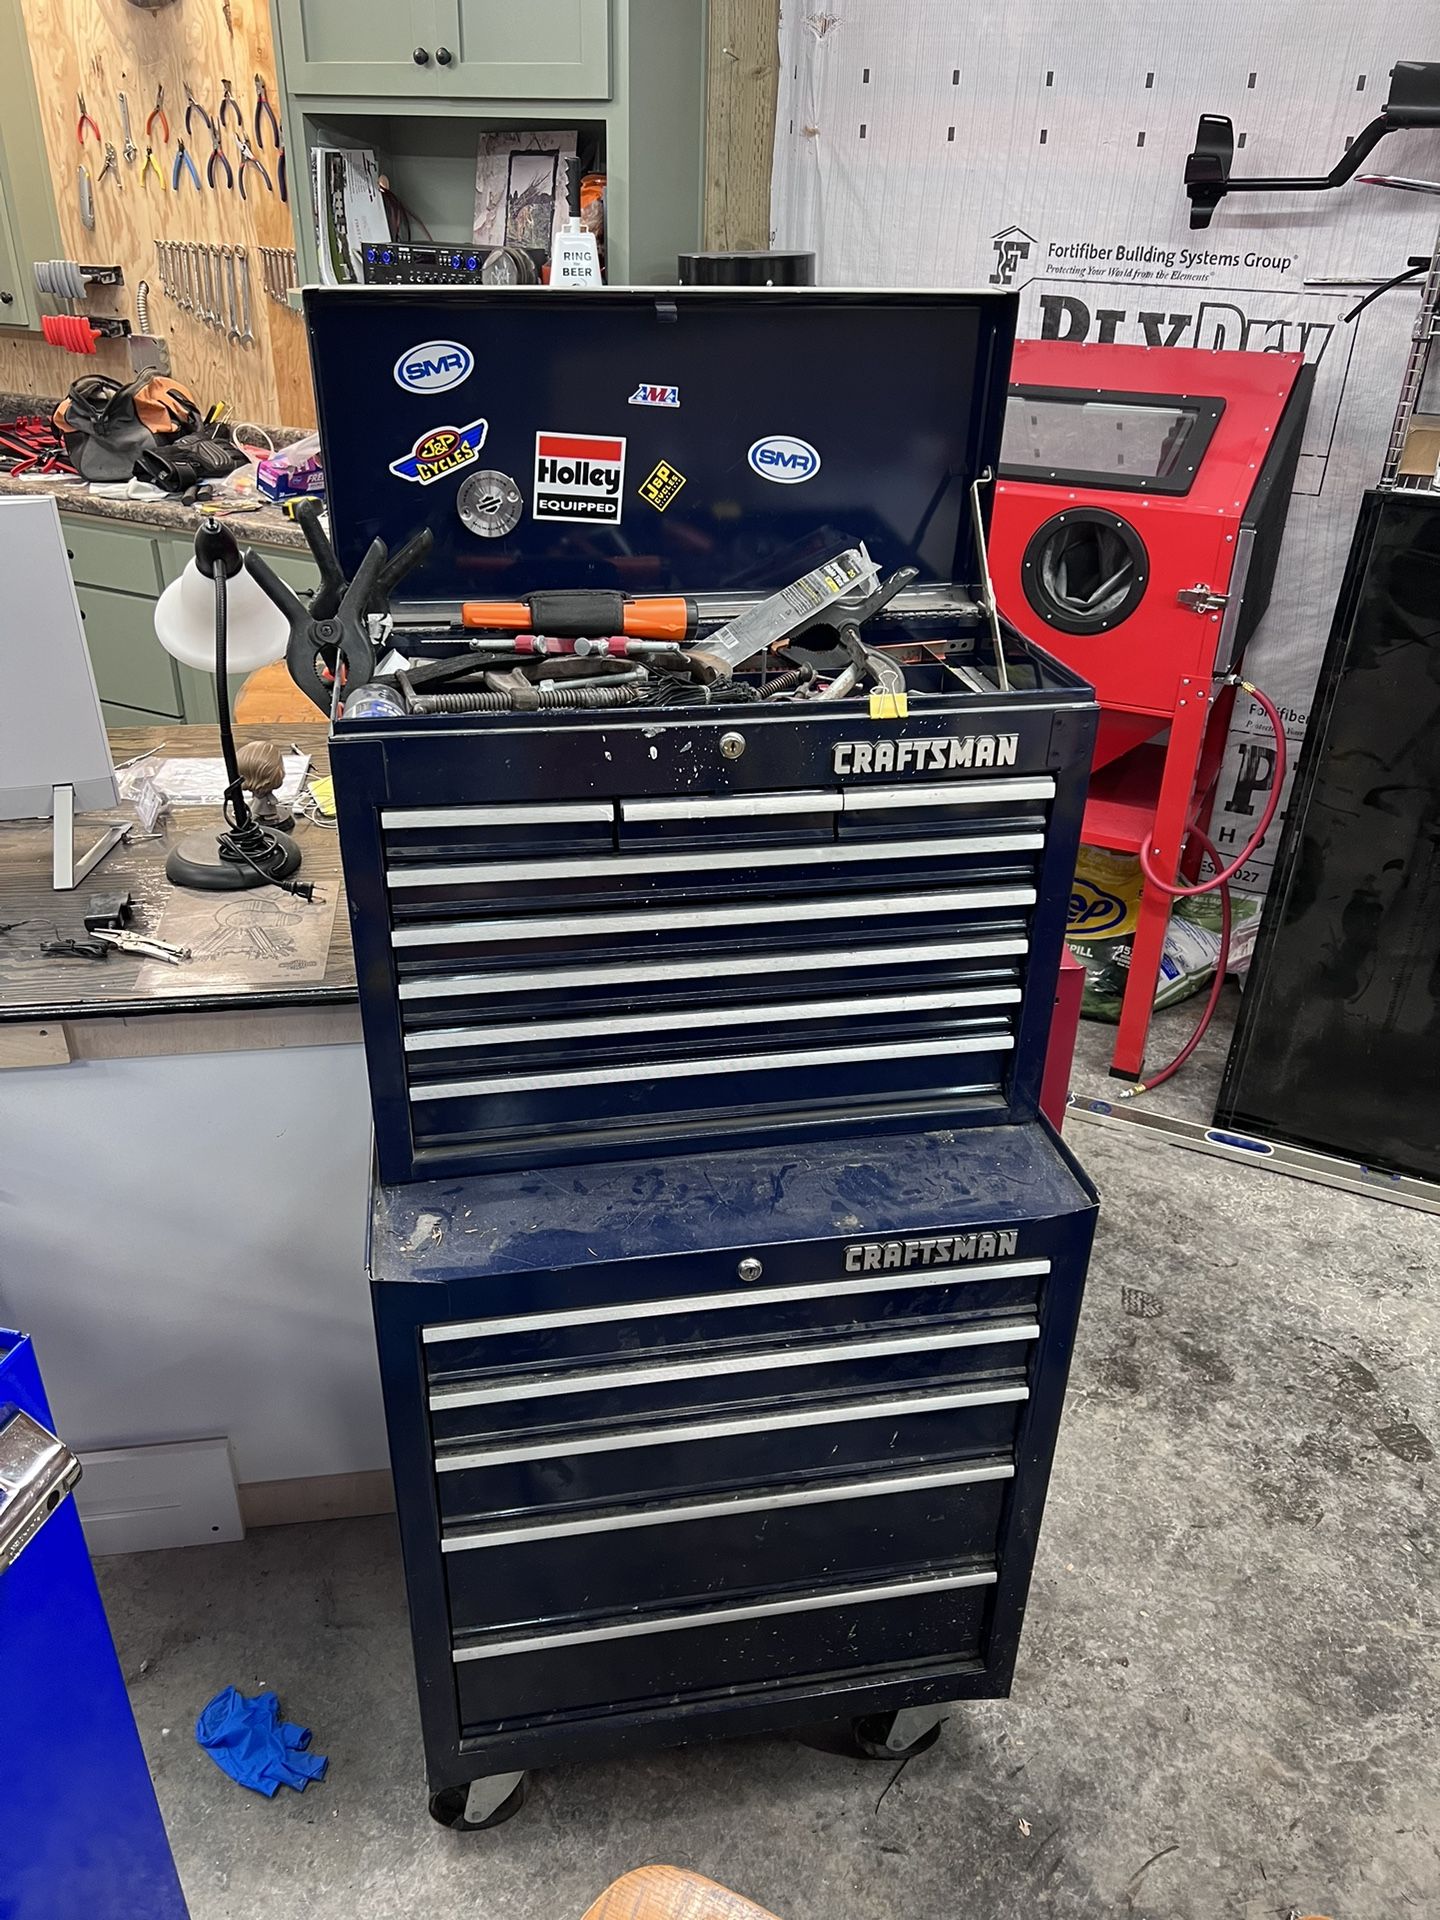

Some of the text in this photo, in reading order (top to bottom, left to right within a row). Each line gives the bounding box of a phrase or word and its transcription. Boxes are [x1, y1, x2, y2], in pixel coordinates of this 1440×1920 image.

[563, 251, 592, 261] RING
[1048, 242, 1113, 260] Fortifiber
[1116, 245, 1176, 268] Building
[1180, 249, 1240, 268] Systems
[562, 267, 592, 277] BEER
[1046, 264, 1210, 281] Protecting Your World from the Elements
[406, 353, 463, 381] SMR
[632, 386, 678, 402] AMA
[421, 434, 455, 458] J&P
[416, 440, 475, 481] CYCLES
[758, 449, 810, 471] SMR
[538, 458, 621, 495] Holley
[654, 475, 679, 505] CYCLES
[538, 499, 616, 513] EQUIPPED
[832, 733, 1020, 775] CRAFTSMAN
[1228, 868, 1260, 883] 027
[1066, 893, 1114, 924] ep
[1067, 943, 1094, 958] PILL
[844, 1229, 1019, 1272] CRAFTSMAN
